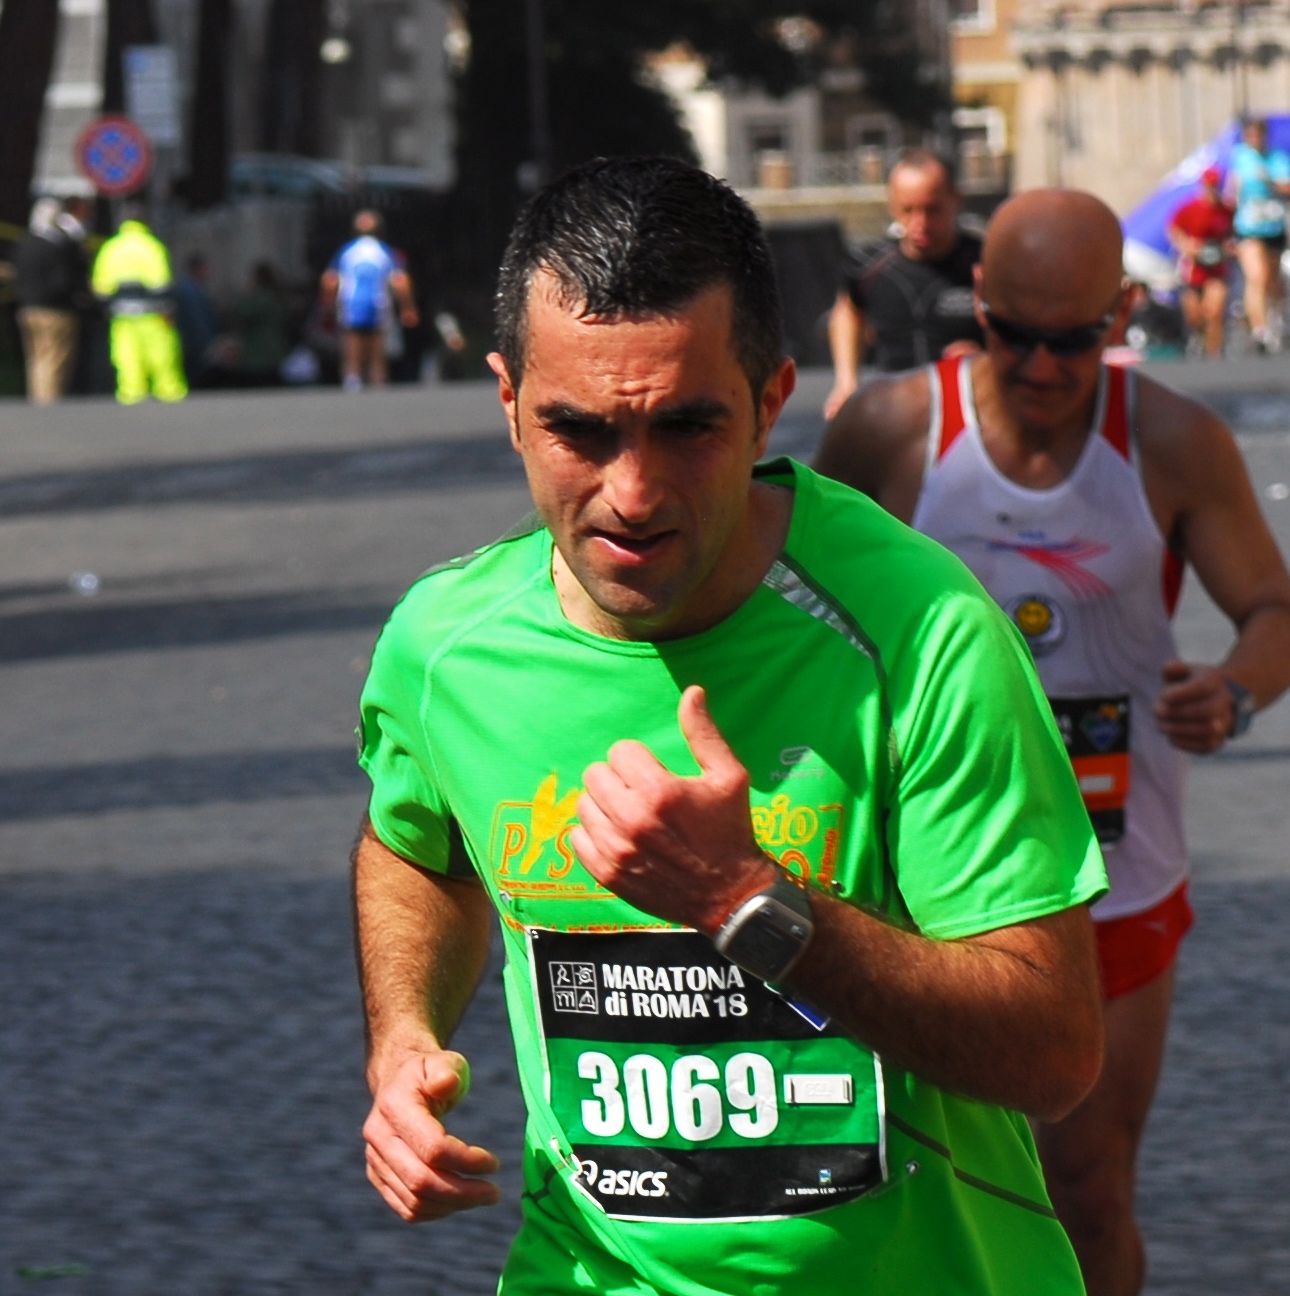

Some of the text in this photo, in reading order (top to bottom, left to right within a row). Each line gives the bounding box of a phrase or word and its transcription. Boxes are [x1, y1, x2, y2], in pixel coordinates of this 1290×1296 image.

[602, 963, 745, 992] MARATONA
[605, 990, 626, 1017] di
[577, 1051, 779, 1142] 3069
[597, 1169, 669, 1198] asics
